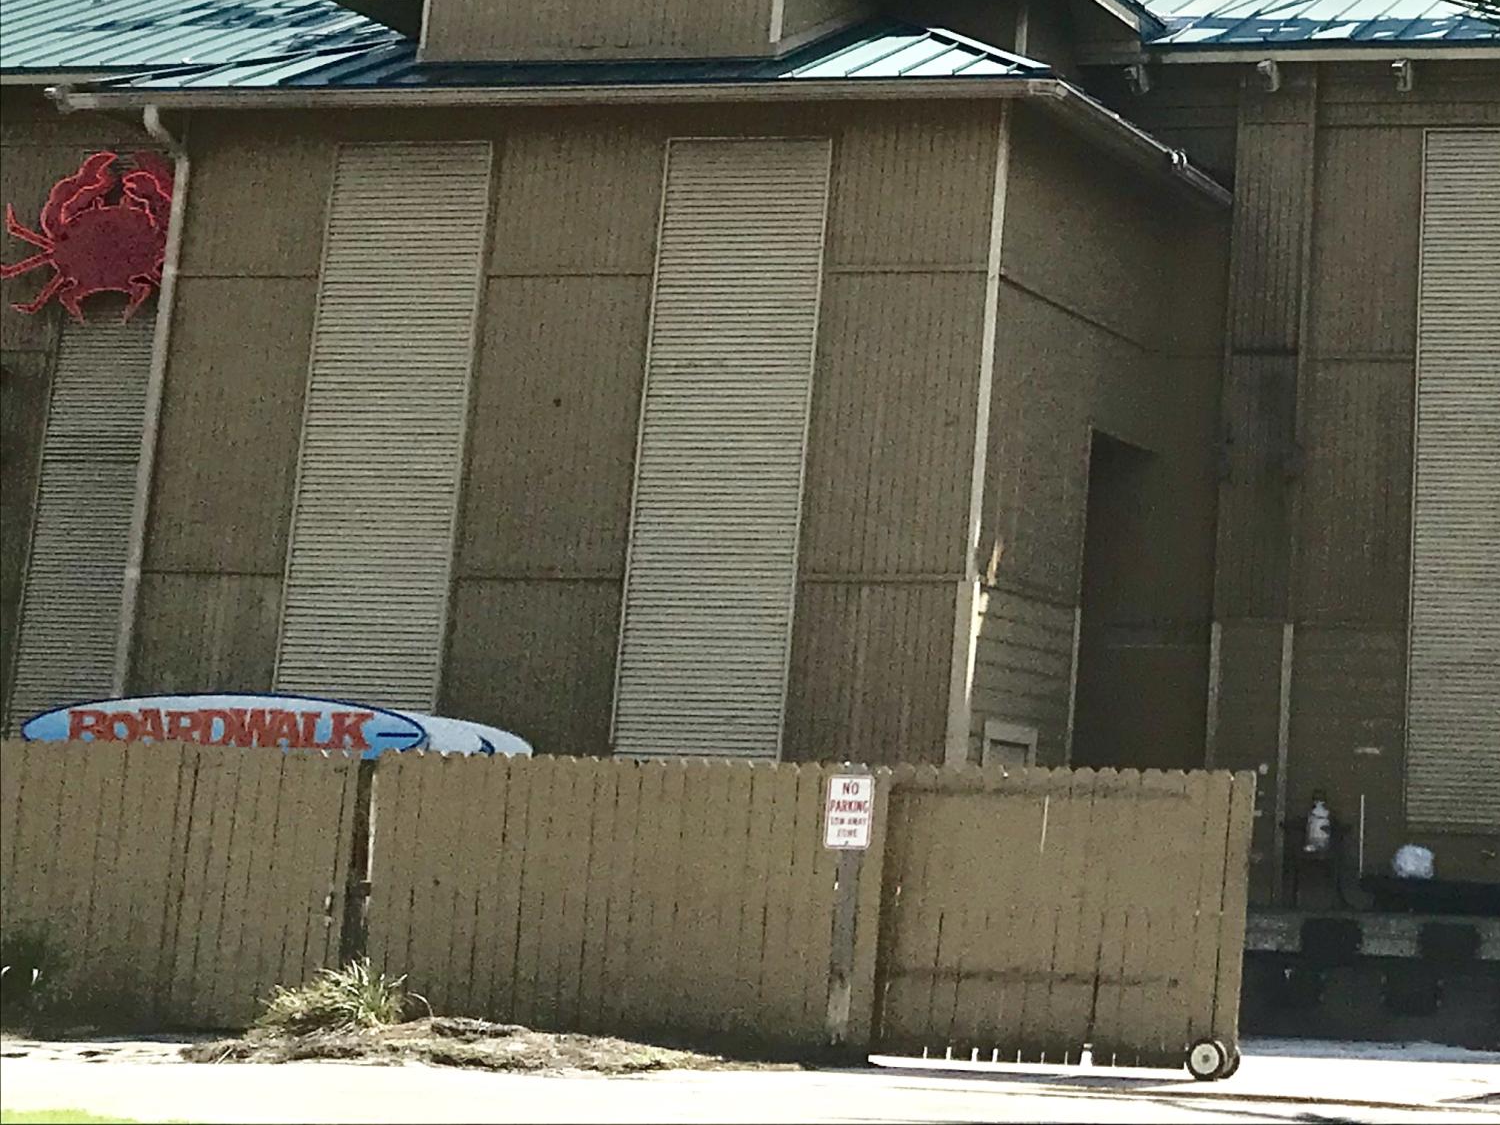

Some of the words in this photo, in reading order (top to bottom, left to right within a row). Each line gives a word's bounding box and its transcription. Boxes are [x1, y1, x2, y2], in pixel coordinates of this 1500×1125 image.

[67, 708, 374, 750] BOARDWALK
[842, 782, 860, 795] NO
[830, 800, 869, 813] PARKING
